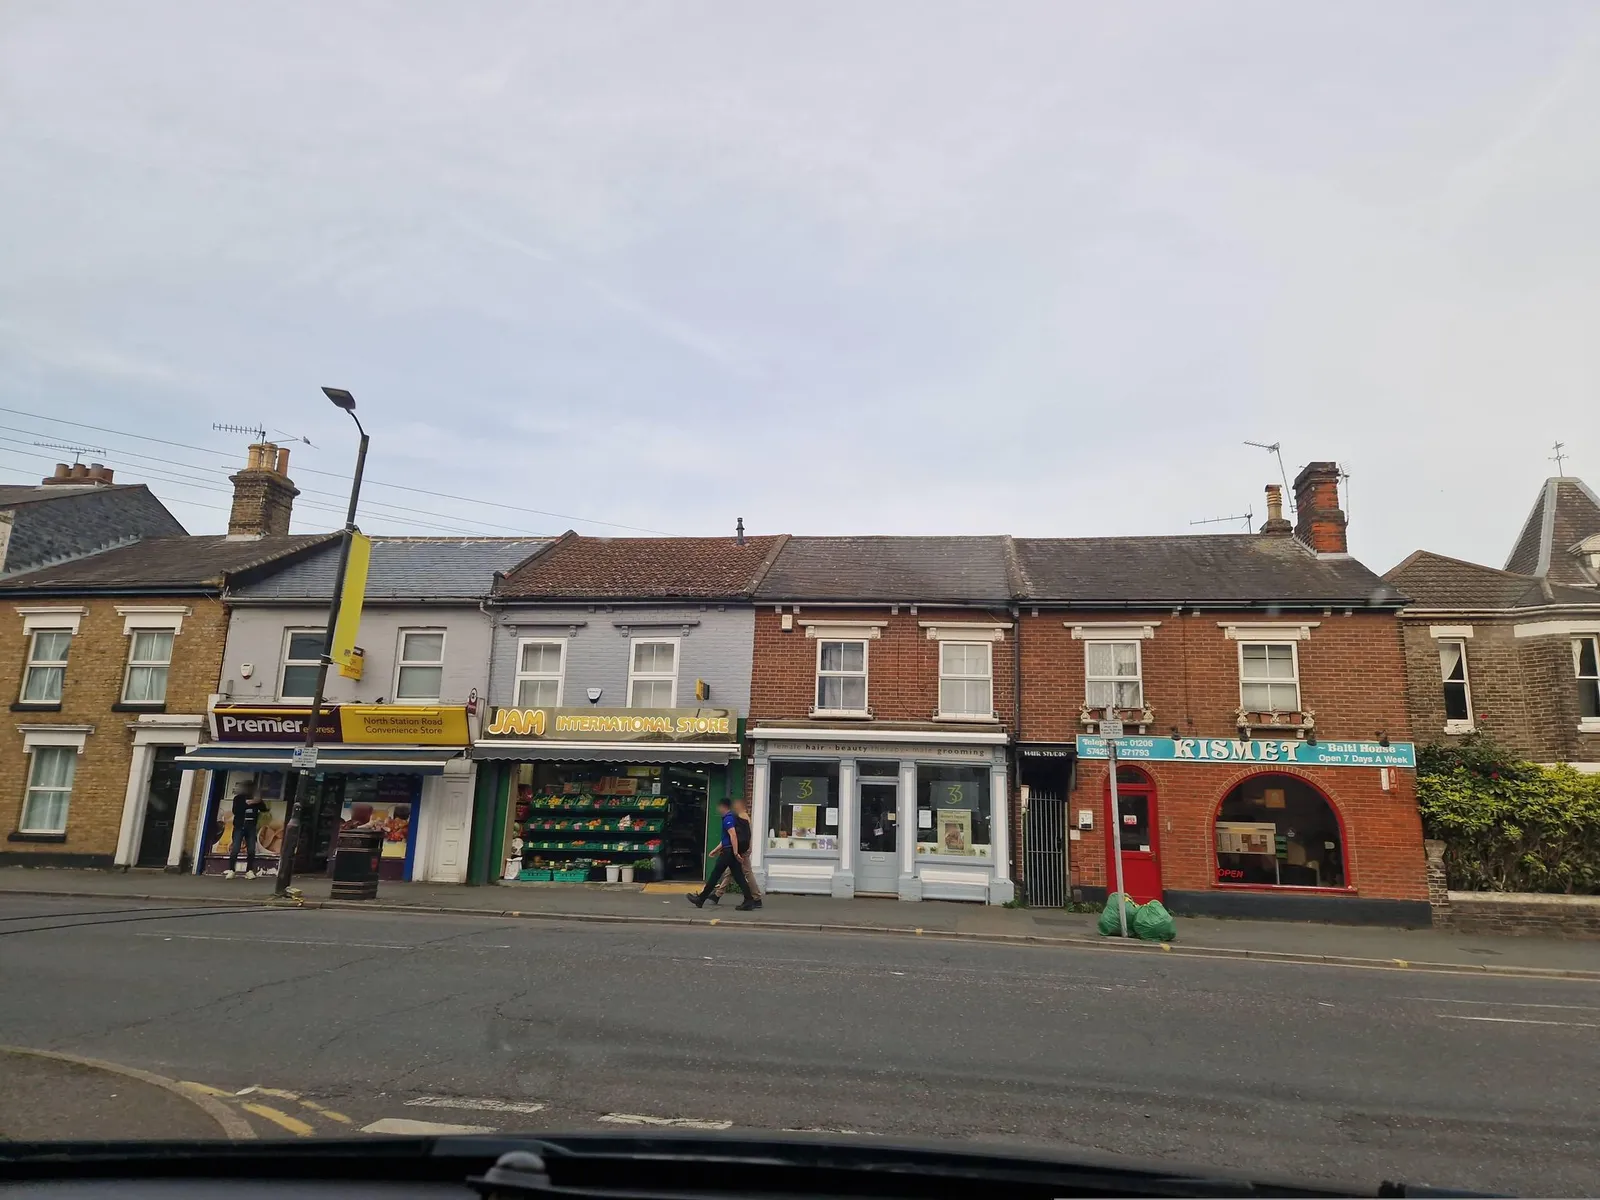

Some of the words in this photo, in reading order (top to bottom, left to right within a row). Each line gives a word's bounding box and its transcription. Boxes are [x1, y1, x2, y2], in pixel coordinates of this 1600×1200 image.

[222, 716, 303, 732] Premier
[303, 726, 335, 734] eress
[363, 717, 388, 725] North
[390, 717, 419, 725] Station
[421, 718, 443, 726] Road
[488, 709, 545, 735] JAM
[555, 715, 674, 733] INTERNATIONAL
[676, 717, 730, 733] STORE
[365, 725, 418, 734] Convenience
[420, 726, 443, 734] Store
[1082, 738, 1128, 747] Telepne:
[1129, 739, 1154, 747] 01206
[773, 743, 802, 751] female
[805, 743, 825, 751] hair
[834, 743, 868, 753] beauty
[937, 747, 985, 757] grooming
[1121, 748, 1150, 757] 571793
[1173, 739, 1300, 762] KISMET
[1327, 743, 1357, 753] Balti
[1359, 744, 1396, 754] House
[1318, 754, 1342, 763] Open
[1343, 754, 1350, 762] 7
[1351, 755, 1373, 764] Days
[1375, 755, 1382, 763] A
[1383, 755, 1408, 764] Week
[796, 779, 813, 799] 33
[945, 784, 963, 805] 33
[1218, 868, 1245, 878] OPEN
